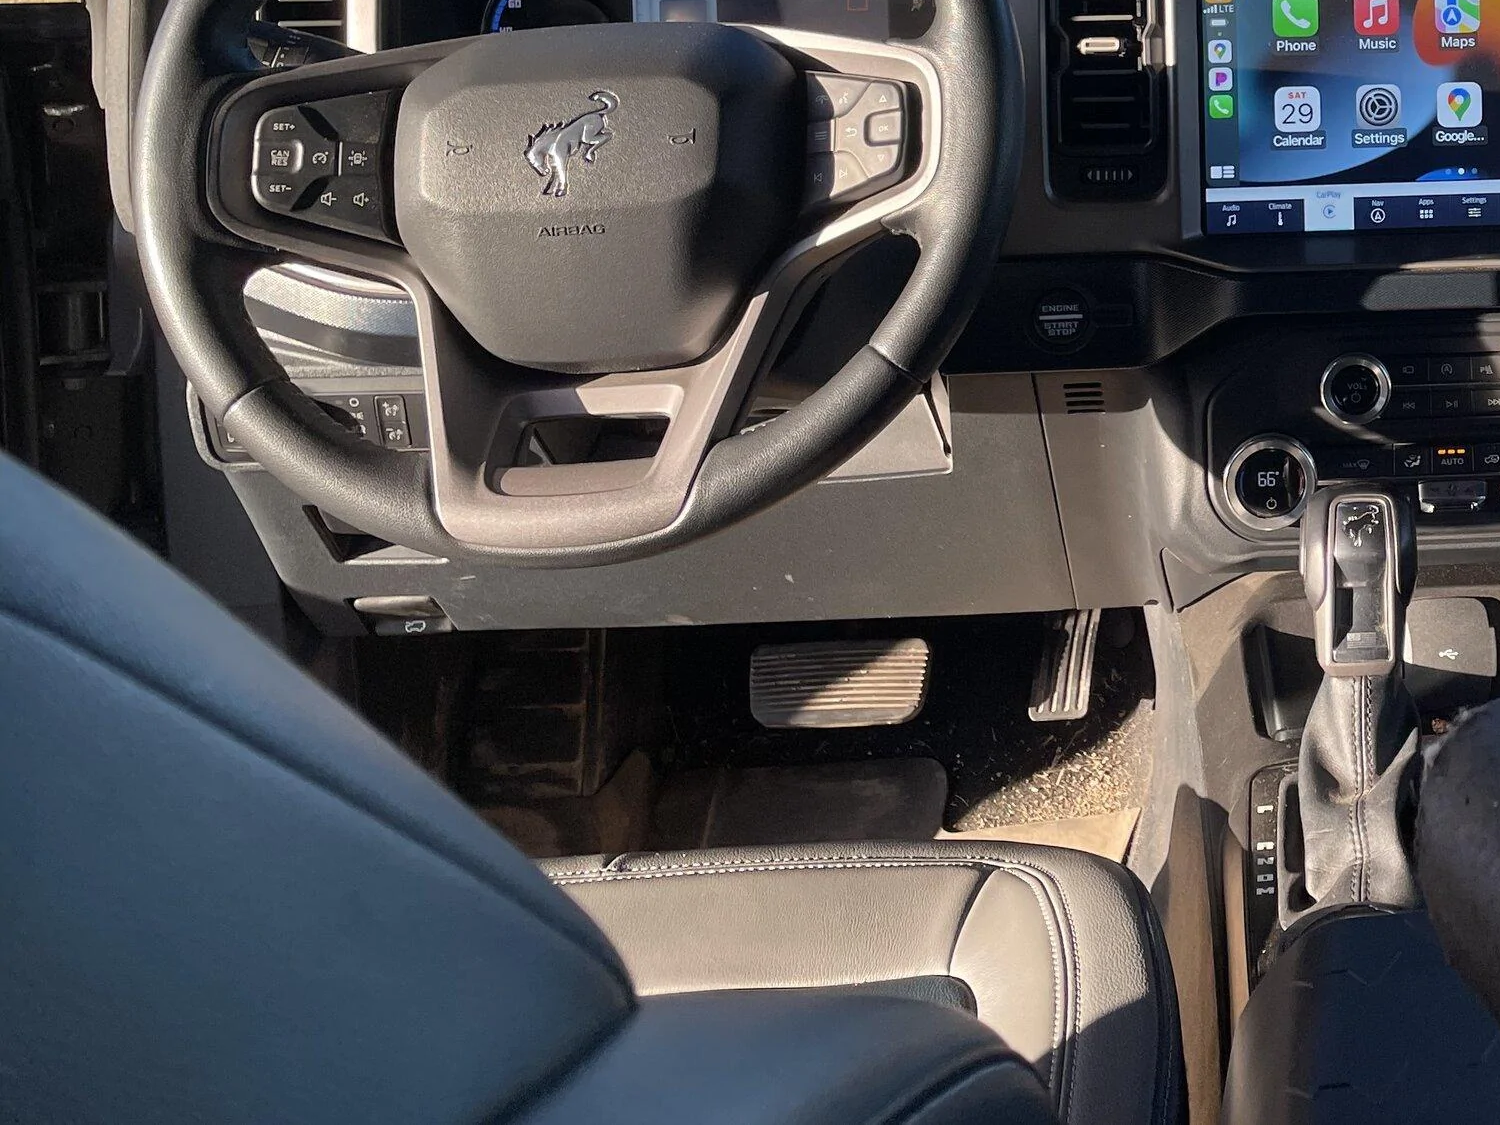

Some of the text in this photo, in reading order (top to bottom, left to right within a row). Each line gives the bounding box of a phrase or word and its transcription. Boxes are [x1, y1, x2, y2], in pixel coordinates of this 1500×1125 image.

[508, 0, 522, 8] 60
[1219, 5, 1234, 13] LTE
[1276, 40, 1317, 52] Phone
[1359, 38, 1396, 50] Music
[1441, 36, 1476, 49] Maps
[1288, 91, 1307, 100] SAT
[1282, 103, 1314, 124] 29
[273, 123, 295, 131] SET+
[878, 124, 889, 133] OK
[1273, 134, 1324, 147] Calendar
[1354, 132, 1405, 145] Settings
[270, 149, 290, 157] CAN
[271, 158, 288, 166] RES
[1316, 190, 1341, 199] CarPlay
[1371, 199, 1385, 207] Nav
[1418, 198, 1434, 207] Apps
[1461, 196, 1487, 205] Settings
[1222, 203, 1241, 212] Audio
[1268, 202, 1292, 211] Climate
[536, 223, 606, 238] AIRBAG
[1041, 303, 1079, 312] ENGINE
[1044, 321, 1079, 329] START
[1047, 328, 1076, 336] STOP
